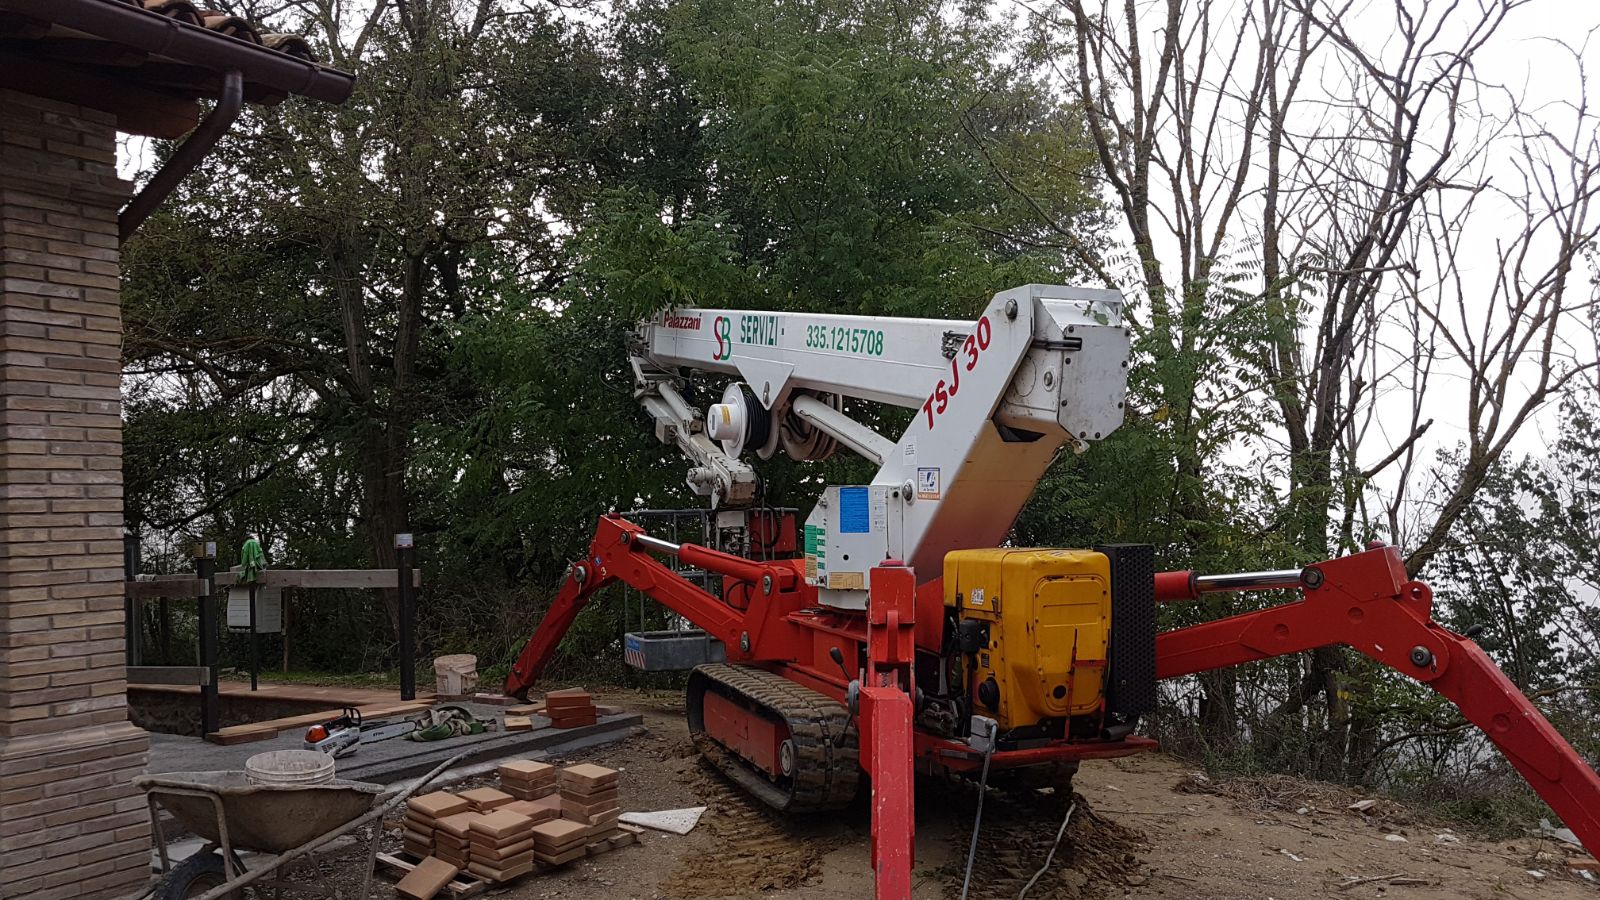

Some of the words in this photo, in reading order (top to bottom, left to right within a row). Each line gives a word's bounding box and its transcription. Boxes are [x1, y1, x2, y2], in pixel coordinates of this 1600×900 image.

[663, 311, 702, 330] Palazzani
[741, 315, 778, 346] SERVIZI
[713, 315, 732, 360] SB
[806, 324, 884, 356] 335.1215708
[922, 358, 960, 431] TSJ
[963, 315, 992, 372] 30
